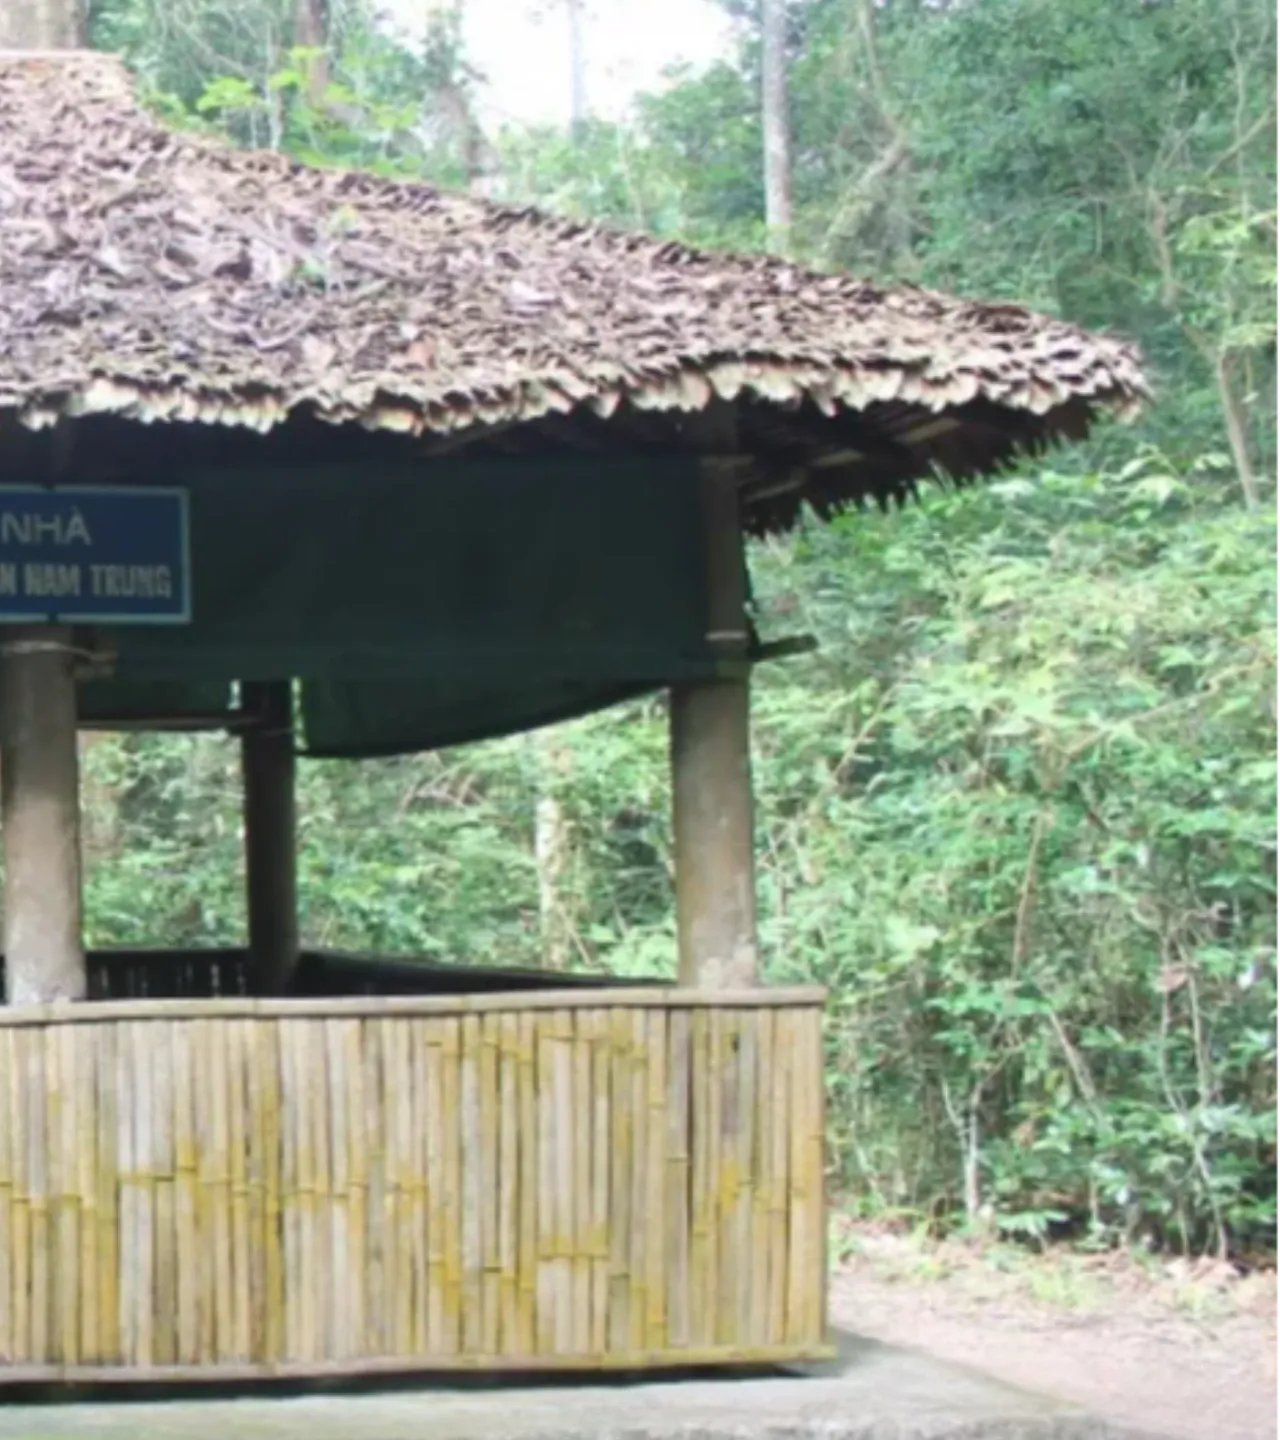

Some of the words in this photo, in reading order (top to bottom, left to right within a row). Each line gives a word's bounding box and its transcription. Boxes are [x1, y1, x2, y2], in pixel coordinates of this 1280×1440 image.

[0, 505, 92, 545] NHÀ
[24, 562, 81, 597] NAM
[90, 564, 172, 599] TRUNG
